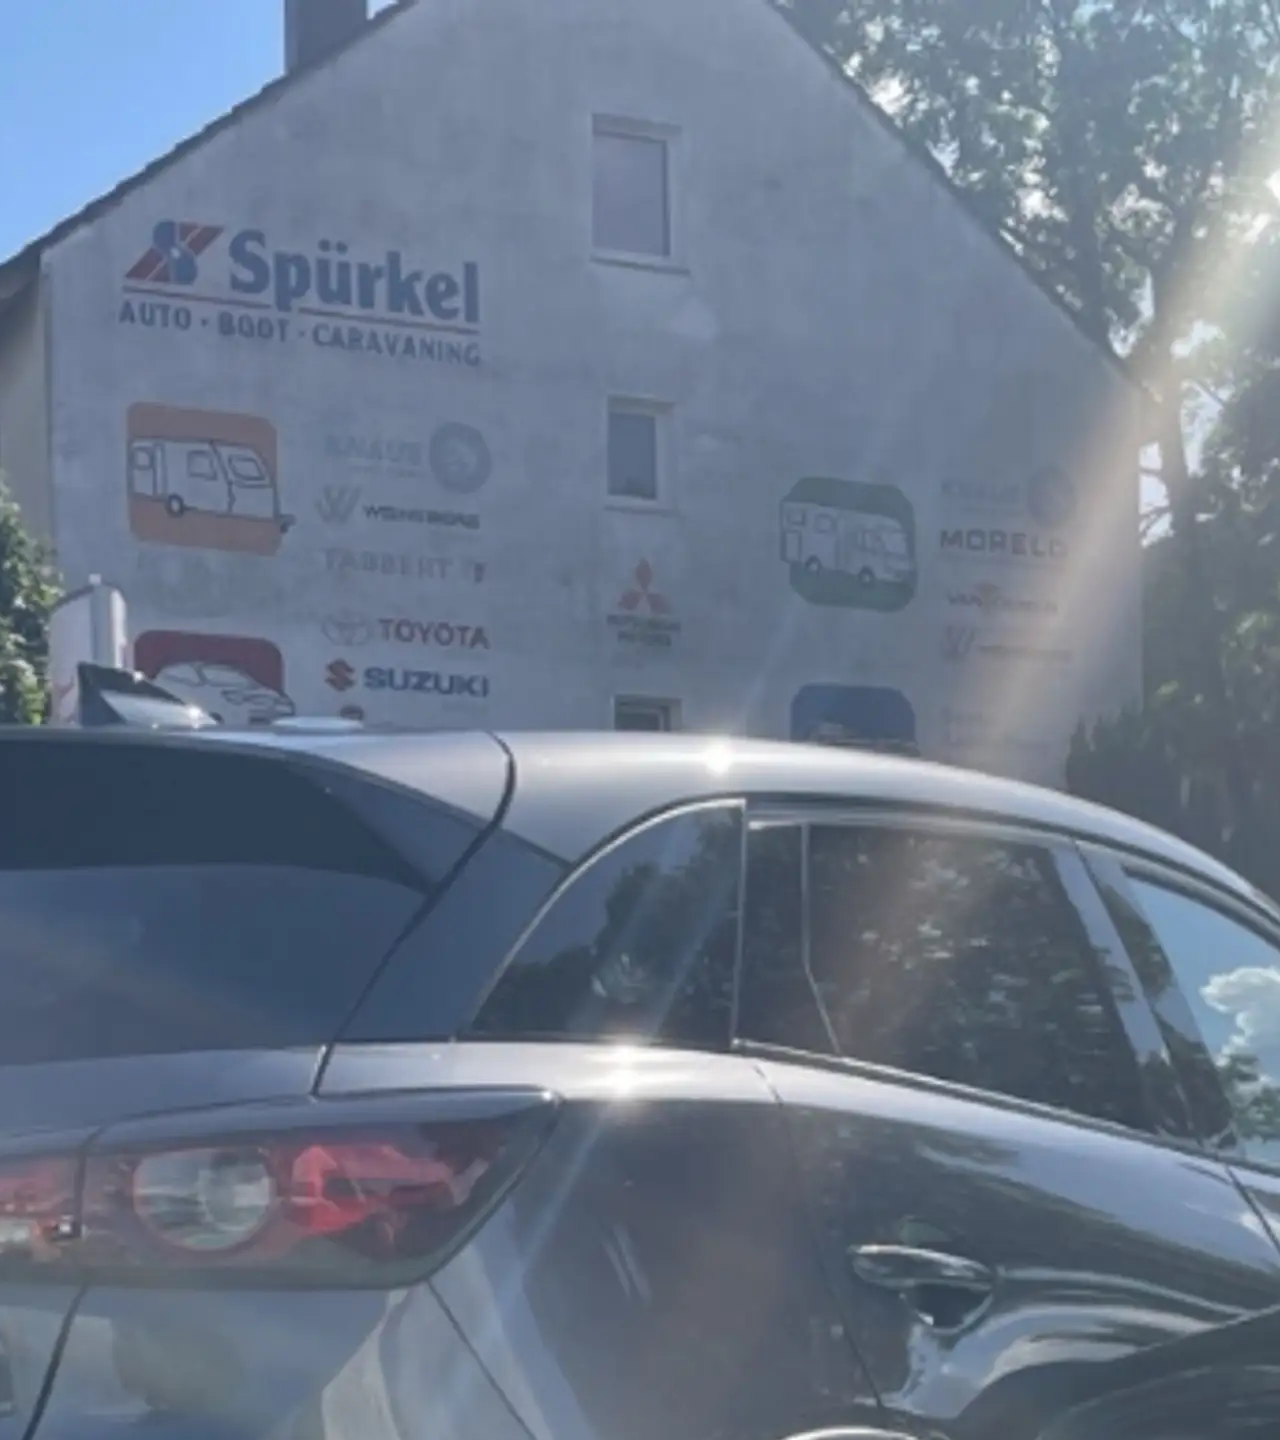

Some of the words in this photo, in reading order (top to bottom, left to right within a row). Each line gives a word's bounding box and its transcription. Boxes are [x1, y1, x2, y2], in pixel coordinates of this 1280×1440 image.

[227, 227, 481, 323] Spürkel
[119, 299, 192, 332] AUTO
[218, 310, 290, 343] BOOT
[312, 322, 482, 368] CARAVANING
[377, 617, 491, 650] TOYOTA
[363, 666, 490, 699] SUZUKI
